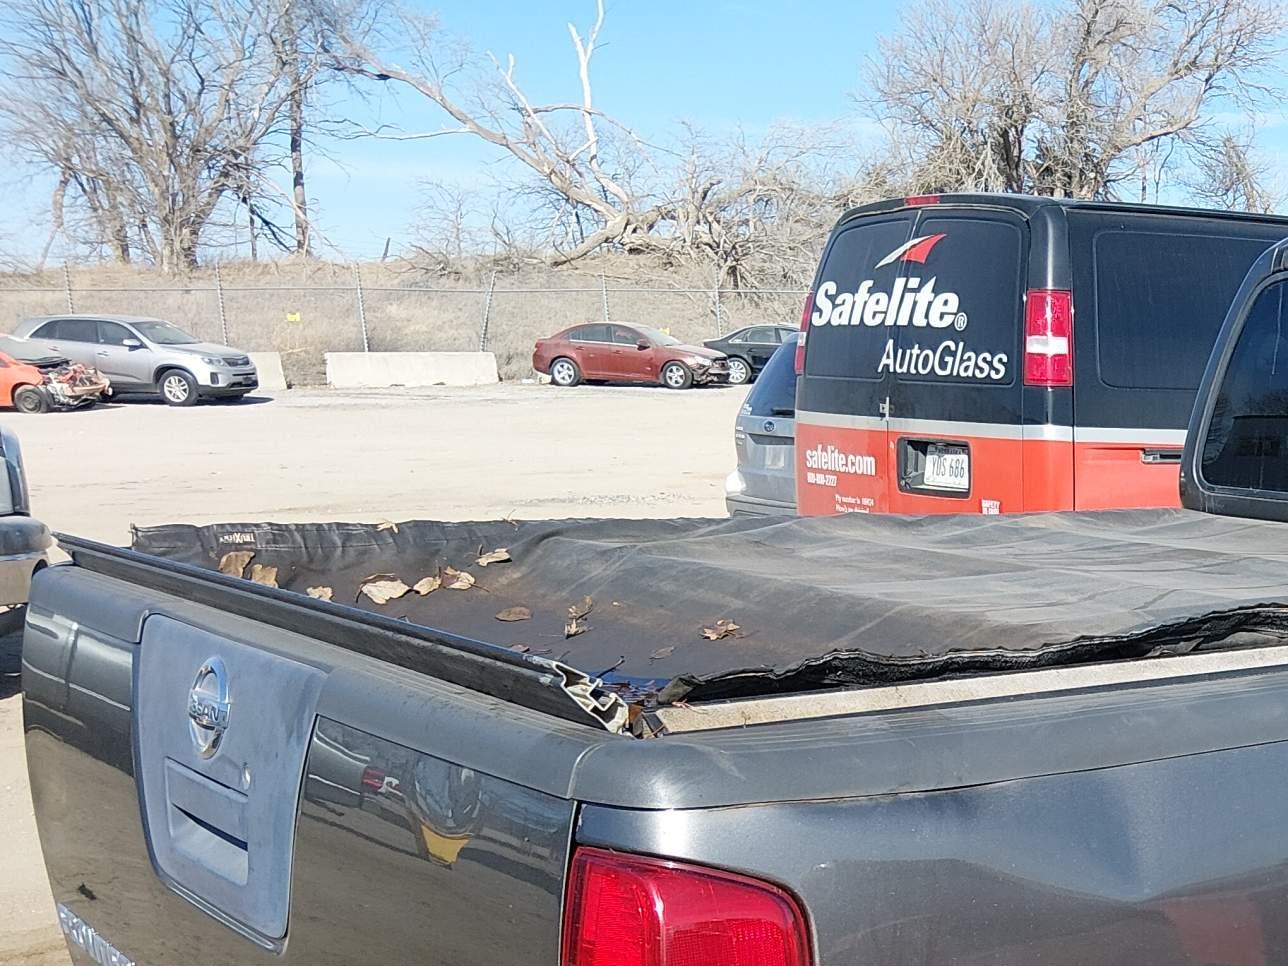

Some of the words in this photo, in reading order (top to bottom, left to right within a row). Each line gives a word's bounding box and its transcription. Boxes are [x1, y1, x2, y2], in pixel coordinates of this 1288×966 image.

[877, 338, 1008, 380] AutoGlass
[805, 444, 876, 476] safelite.com
[948, 458, 965, 479] 686
